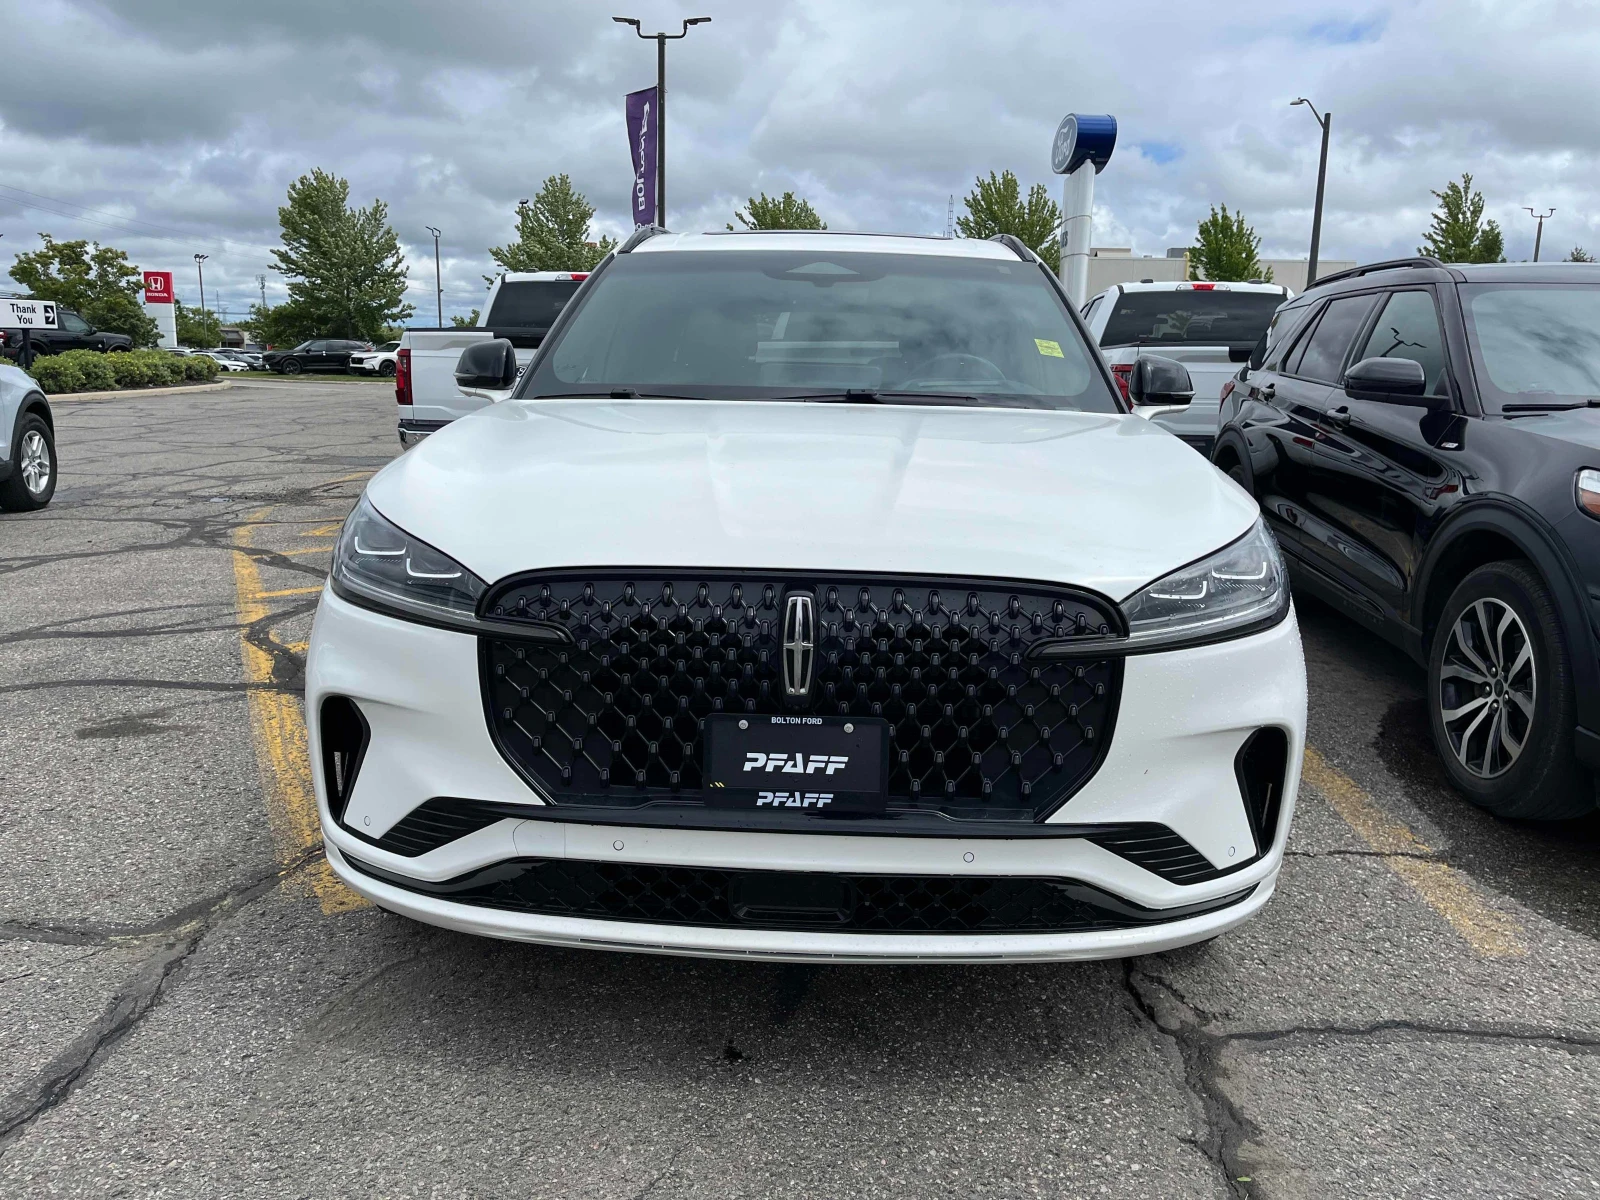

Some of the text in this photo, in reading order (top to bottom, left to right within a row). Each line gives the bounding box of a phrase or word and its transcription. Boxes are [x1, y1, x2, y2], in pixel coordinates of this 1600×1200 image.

[10, 303, 37, 314] Thank
[16, 314, 33, 325] You
[771, 716, 823, 725] BOLTON FORD
[743, 752, 849, 775] PFAFF
[756, 791, 834, 808] PFAFF
